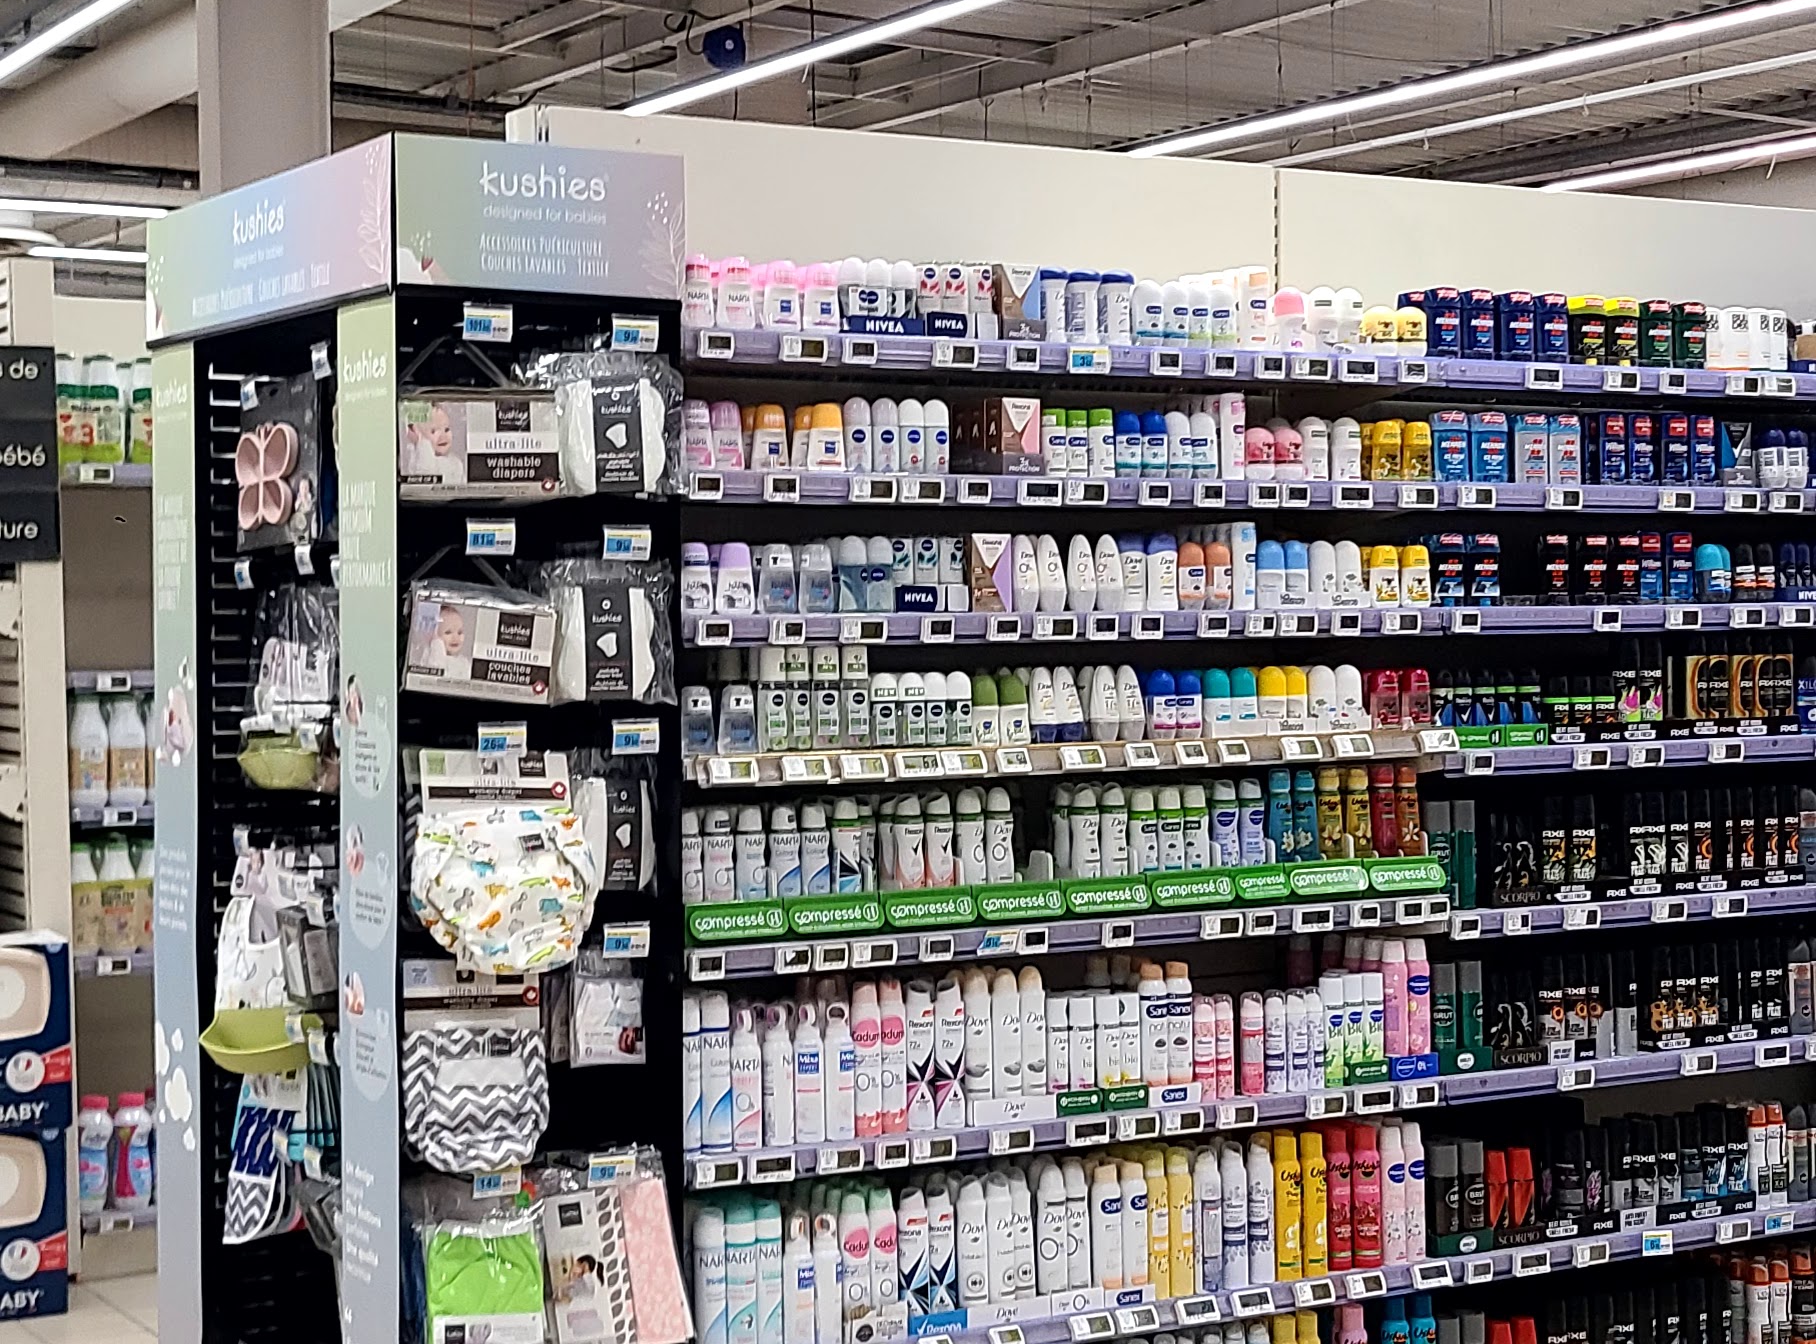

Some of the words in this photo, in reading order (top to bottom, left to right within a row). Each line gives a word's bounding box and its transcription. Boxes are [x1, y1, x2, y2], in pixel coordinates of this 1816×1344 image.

[479, 160, 606, 201] kushies
[483, 203, 542, 222] designed
[546, 208, 562, 221] for
[233, 197, 285, 246] kushies
[866, 319, 905, 333] NIVEA
[934, 319, 964, 330] NIVEA
[9, 358, 38, 380] de
[342, 349, 387, 384] kushies
[0, 444, 45, 467] ébé
[487, 456, 542, 469] washable
[492, 467, 536, 481] diapers
[0, 519, 38, 540] ure
[904, 592, 934, 603] NIVEA
[1798, 591, 1816, 601] NIVE
[488, 661, 532, 674] couches
[487, 671, 531, 684] lavables
[1671, 728, 1690, 737] AXE
[1780, 724, 1798, 733] AXE
[1601, 732, 1620, 740] AXE
[1543, 830, 1565, 838] AXE
[1573, 829, 1595, 837] AXE
[707, 838, 733, 849] NART
[772, 835, 799, 846] NART
[804, 834, 828, 845] NART
[1675, 882, 1695, 891] AXE
[1741, 879, 1759, 887] AXE
[1607, 889, 1627, 897] AXE
[1770, 1026, 1788, 1034] AXE
[703, 1037, 728, 1049] NAR
[1705, 1035, 1724, 1043] AXE
[1500, 1051, 1542, 1064] SCORPIO
[1164, 1089, 1185, 1100] Sanex
[1702, 1145, 1725, 1154] AXE
[1728, 1142, 1748, 1151] AXE
[1632, 1154, 1656, 1163] AXE
[1735, 1201, 1753, 1210] AXE
[1669, 1211, 1687, 1221] AXE
[961, 1222, 985, 1235] Dov
[1594, 1220, 1613, 1230] AXE
[1499, 1232, 1540, 1245] SCORPIO
[1118, 1292, 1141, 1304] Sanex
[996, 1306, 1019, 1319] Dove
